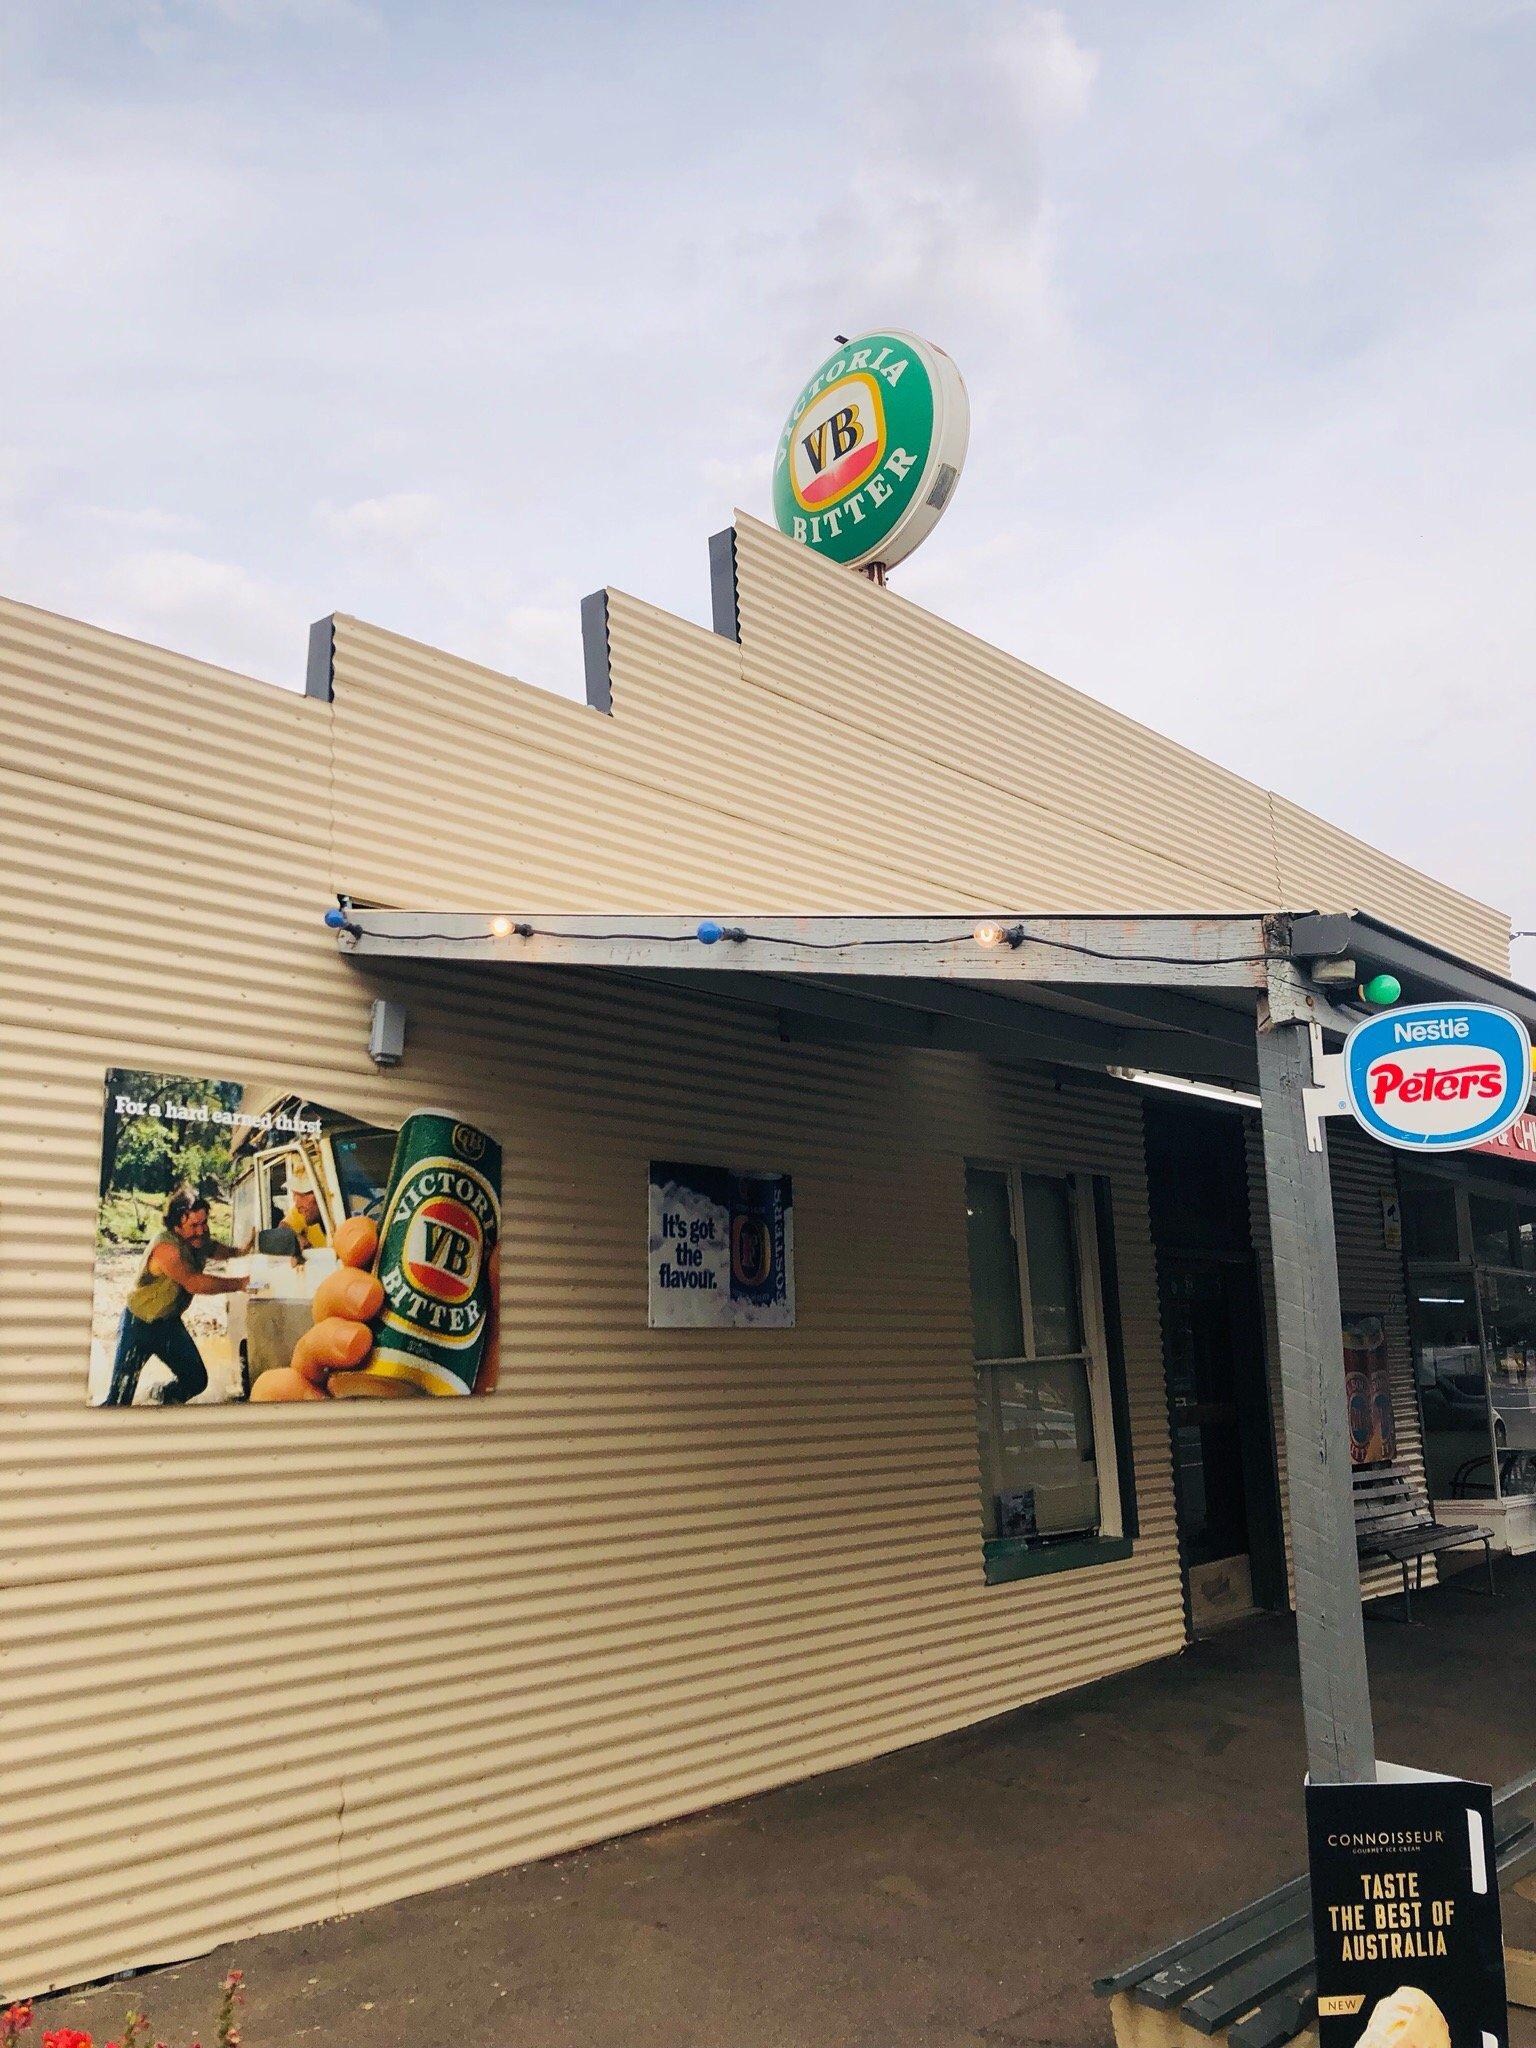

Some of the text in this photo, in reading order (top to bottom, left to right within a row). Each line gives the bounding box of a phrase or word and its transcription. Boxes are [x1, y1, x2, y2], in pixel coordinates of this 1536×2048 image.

[776, 347, 909, 471] VICTORIA
[802, 403, 865, 474] VB
[793, 447, 917, 545] BITTER
[1394, 1016, 1470, 1043] Nestlé
[1370, 1063, 1503, 1105] Peters
[115, 1096, 323, 1134] For a hard earned thirst
[662, 1213, 715, 1244] It's got
[423, 1220, 475, 1280] VB
[675, 1242, 703, 1267] the
[659, 1263, 718, 1290] flavour.
[381, 1265, 482, 1332] BITTER
[1328, 1830, 1444, 1847] CONNOISSEUR
[1352, 1847, 1384, 1855] GOURMET
[1398, 1845, 1421, 1853] CREAM
[1360, 1872, 1420, 1900] TASTE
[1328, 1900, 1455, 1931] THE BEST OF
[1342, 1931, 1448, 1962] AUSTRALIA
[1328, 2000, 1357, 2011] NEW
